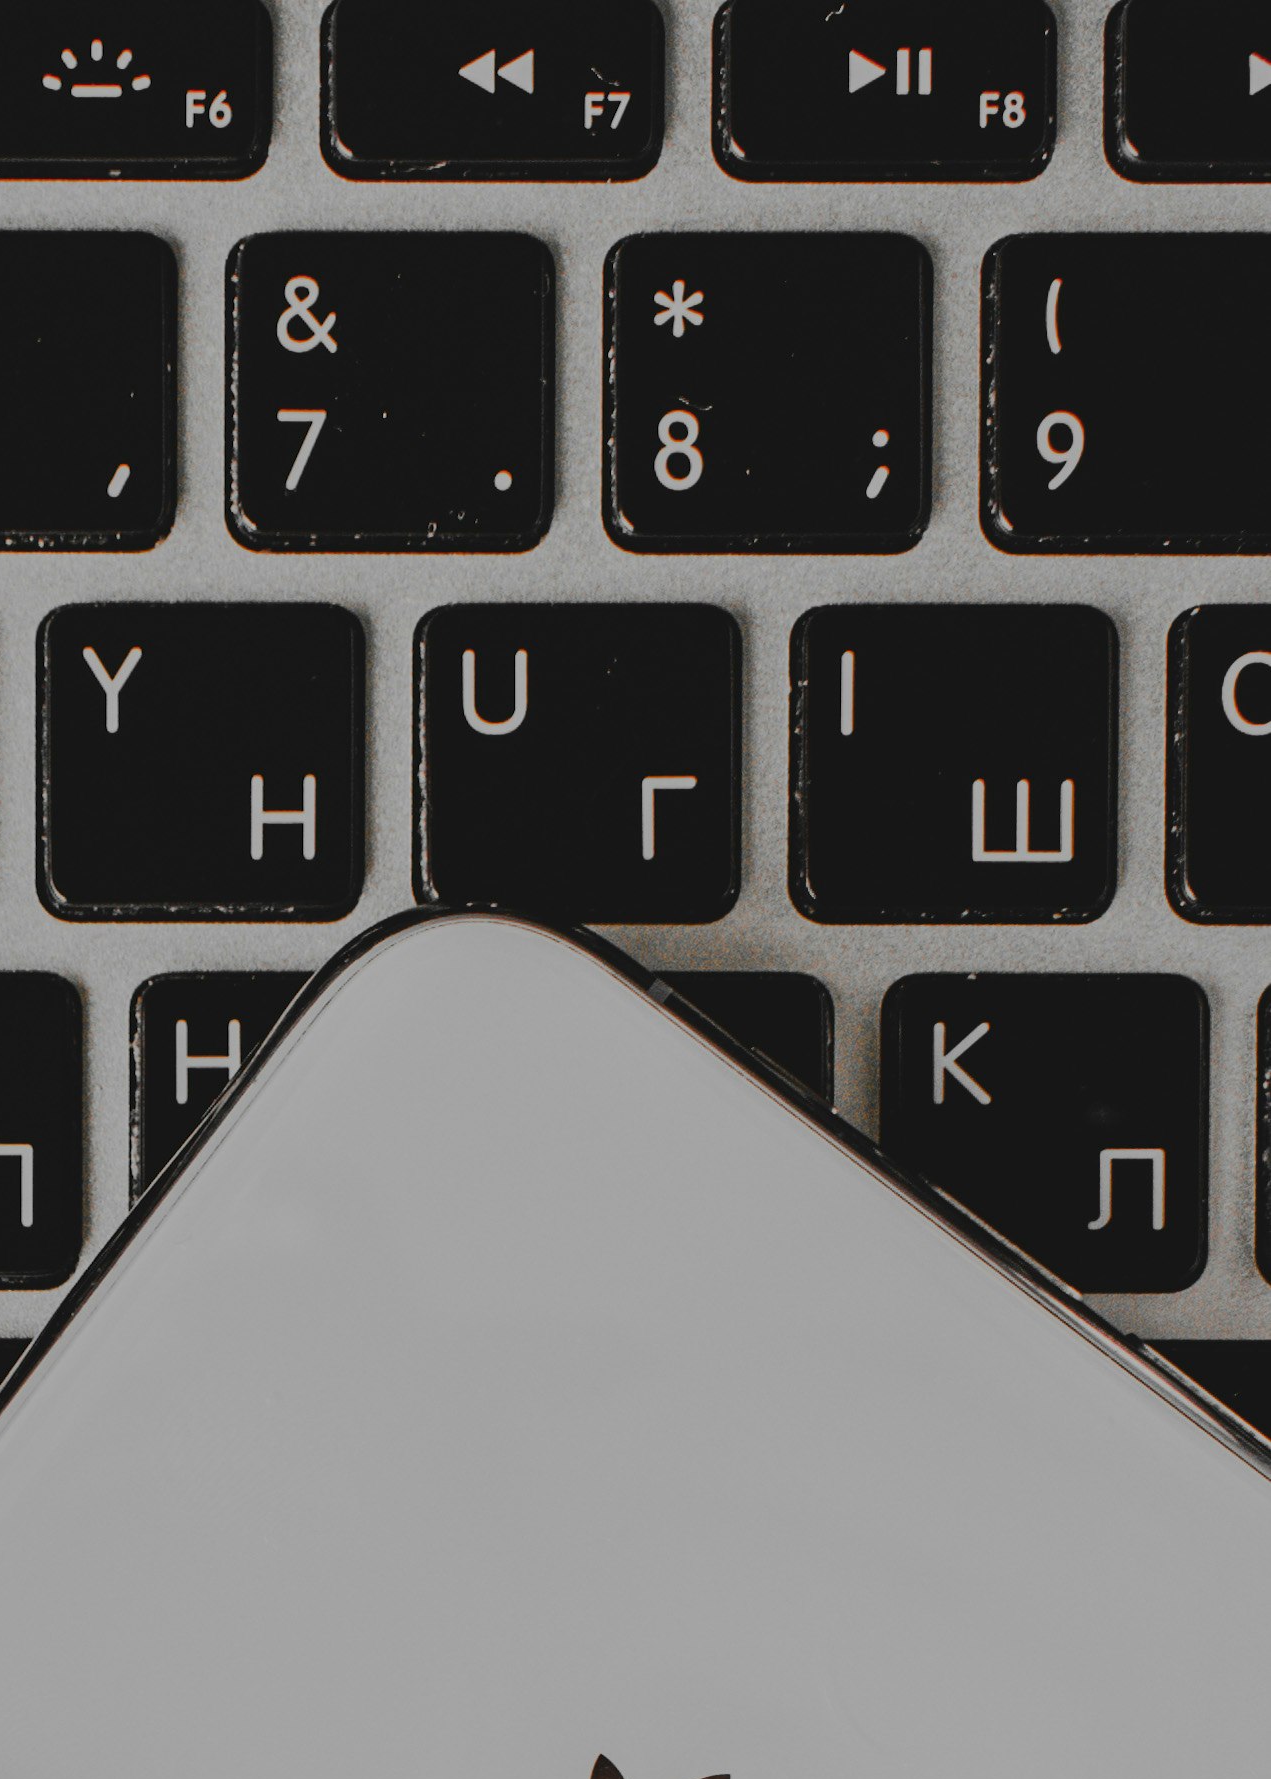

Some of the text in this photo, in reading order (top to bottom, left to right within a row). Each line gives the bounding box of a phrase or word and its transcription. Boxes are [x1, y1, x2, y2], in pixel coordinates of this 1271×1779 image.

[186, 91, 232, 128] F6
[584, 93, 630, 129] F7
[980, 92, 1025, 128] F8
[277, 276, 337, 353] &
[1046, 279, 1061, 354] (
[277, 410, 326, 490] 7
[654, 410, 703, 490] 8
[1037, 412, 1084, 490] 9
[83, 647, 142, 733] Y
[463, 650, 527, 735] U
[841, 651, 854, 735] I
[642, 776, 697, 860] Г
[972, 779, 1073, 862] Ш
[176, 1019, 242, 1104] H
[934, 1023, 991, 1104] K
[1088, 1149, 1165, 1230] Л
